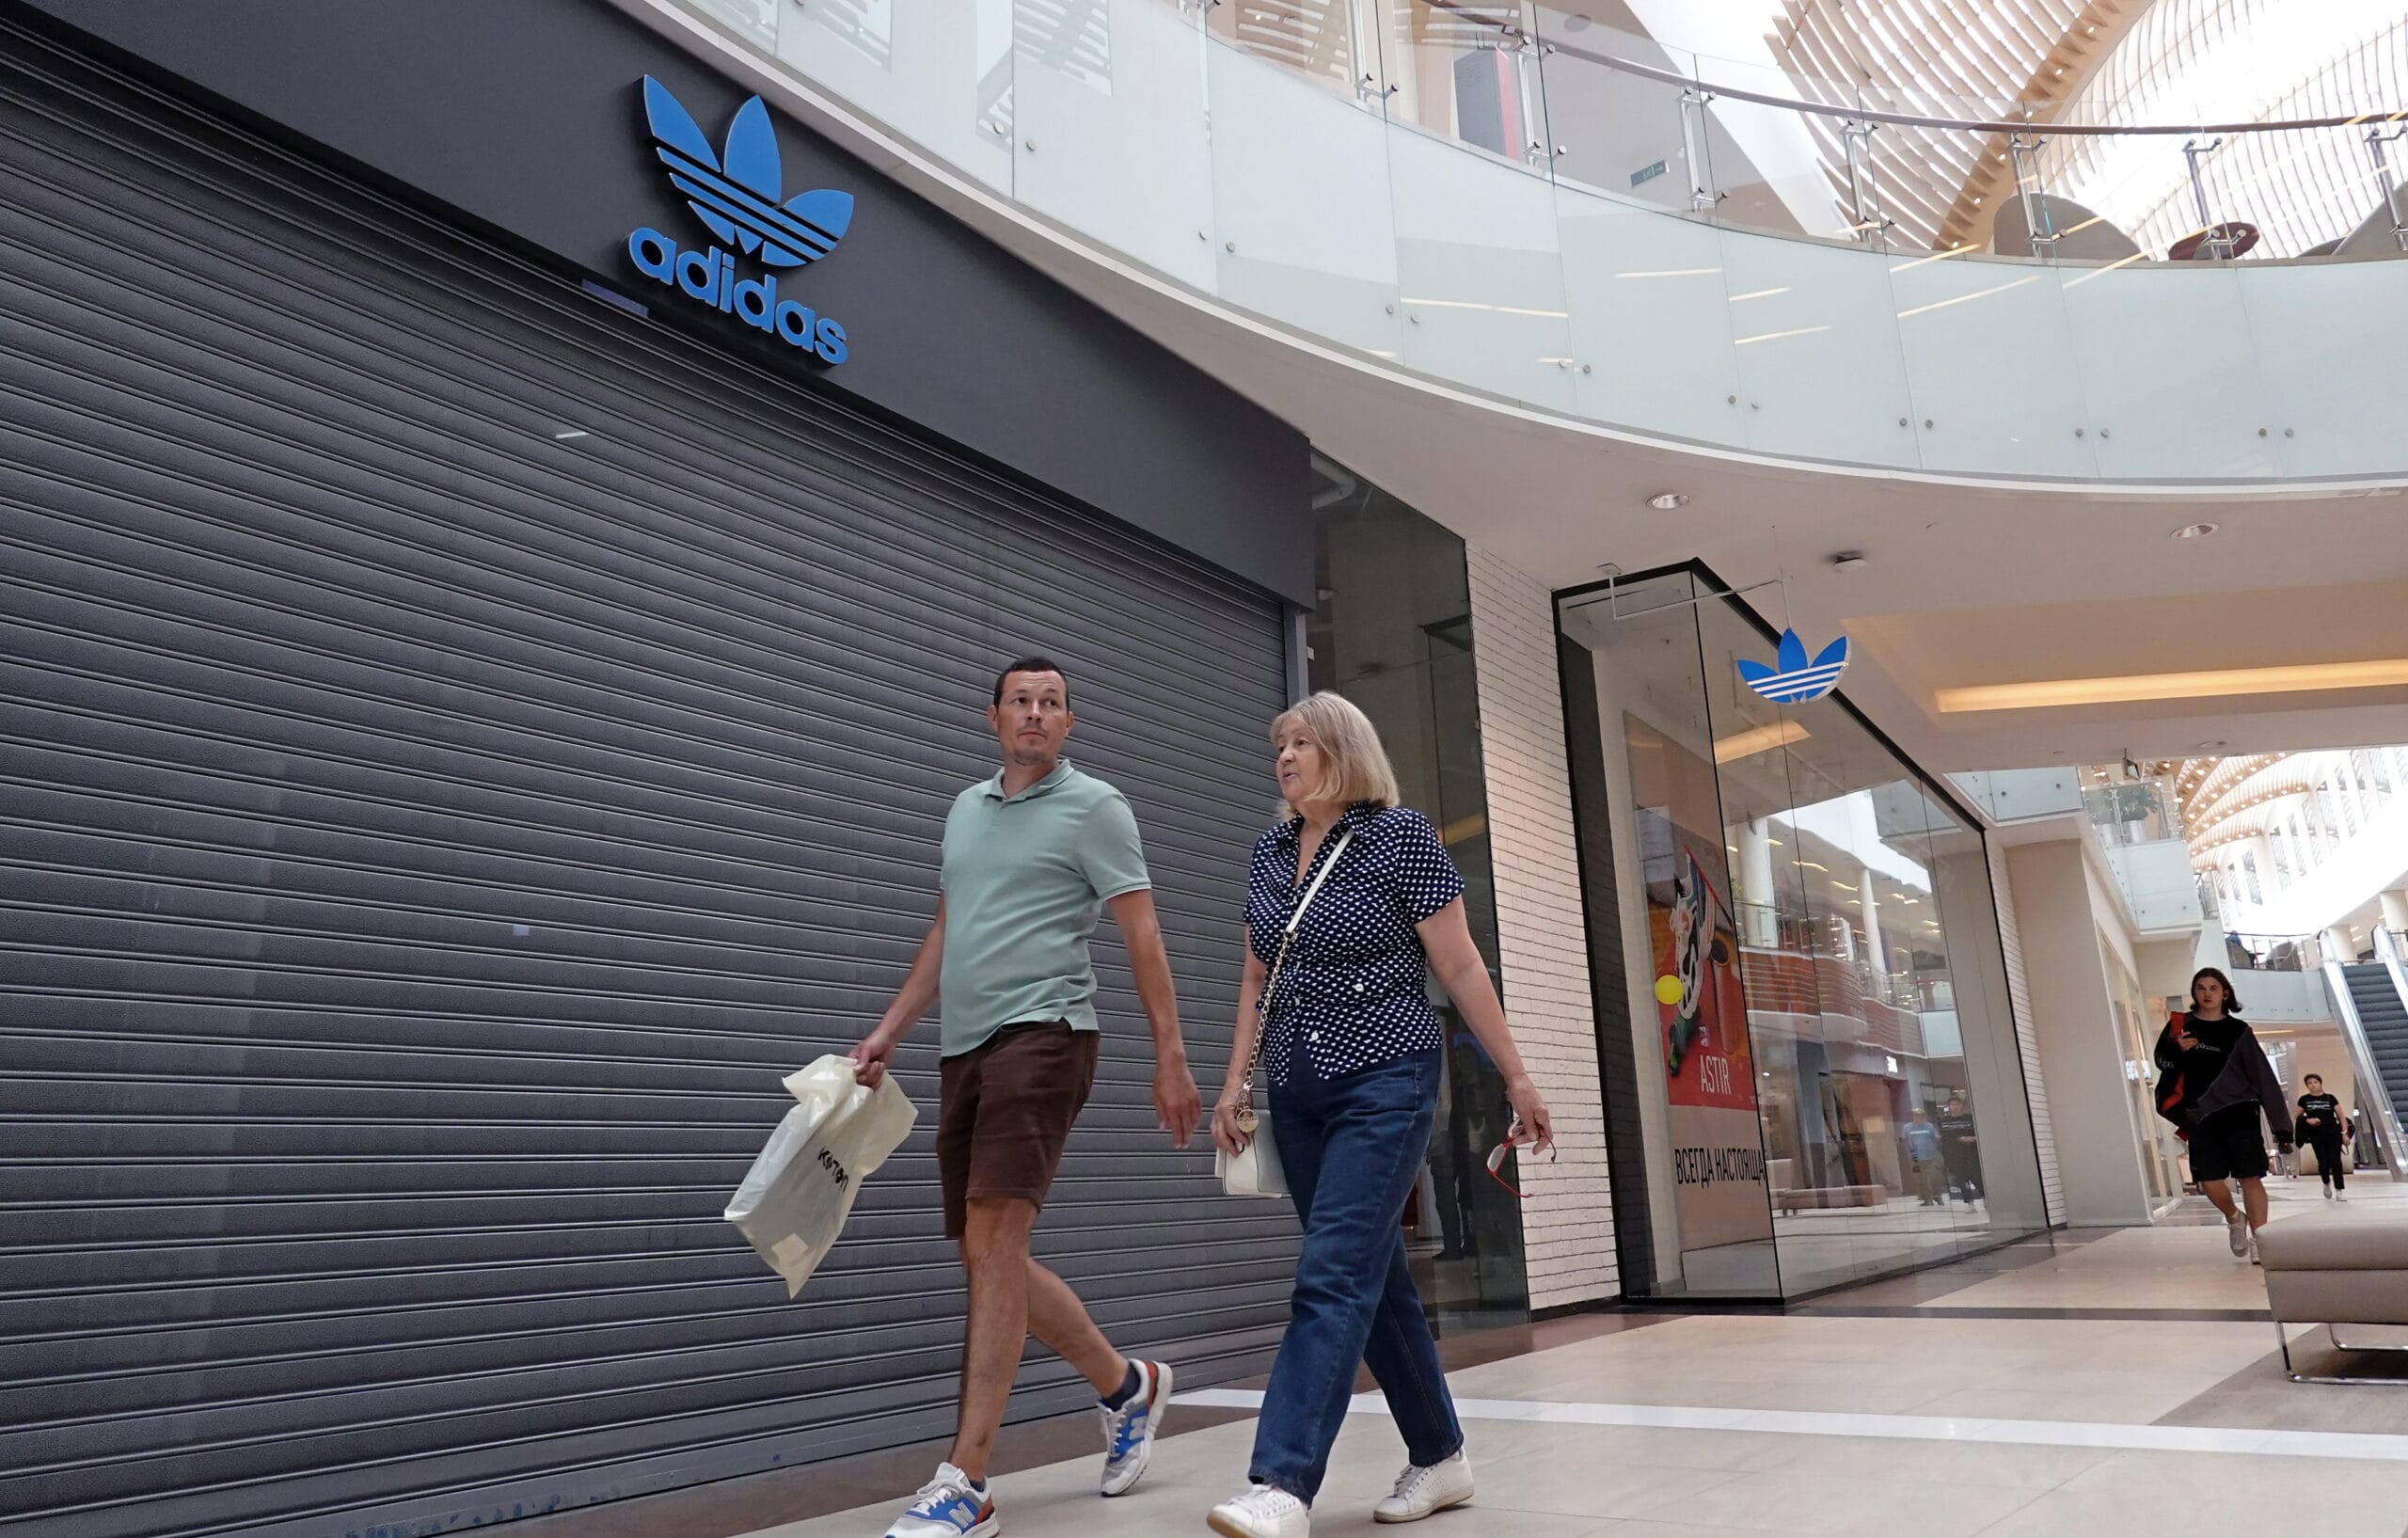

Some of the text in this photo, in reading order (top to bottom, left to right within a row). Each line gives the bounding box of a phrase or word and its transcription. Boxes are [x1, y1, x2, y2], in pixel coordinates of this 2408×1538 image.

[628, 227, 848, 365] adidas
[1700, 1054, 1732, 1096] ASTIR
[1674, 1148, 1715, 1189] ВСЕГДА
[949, 1500, 976, 1529] N
